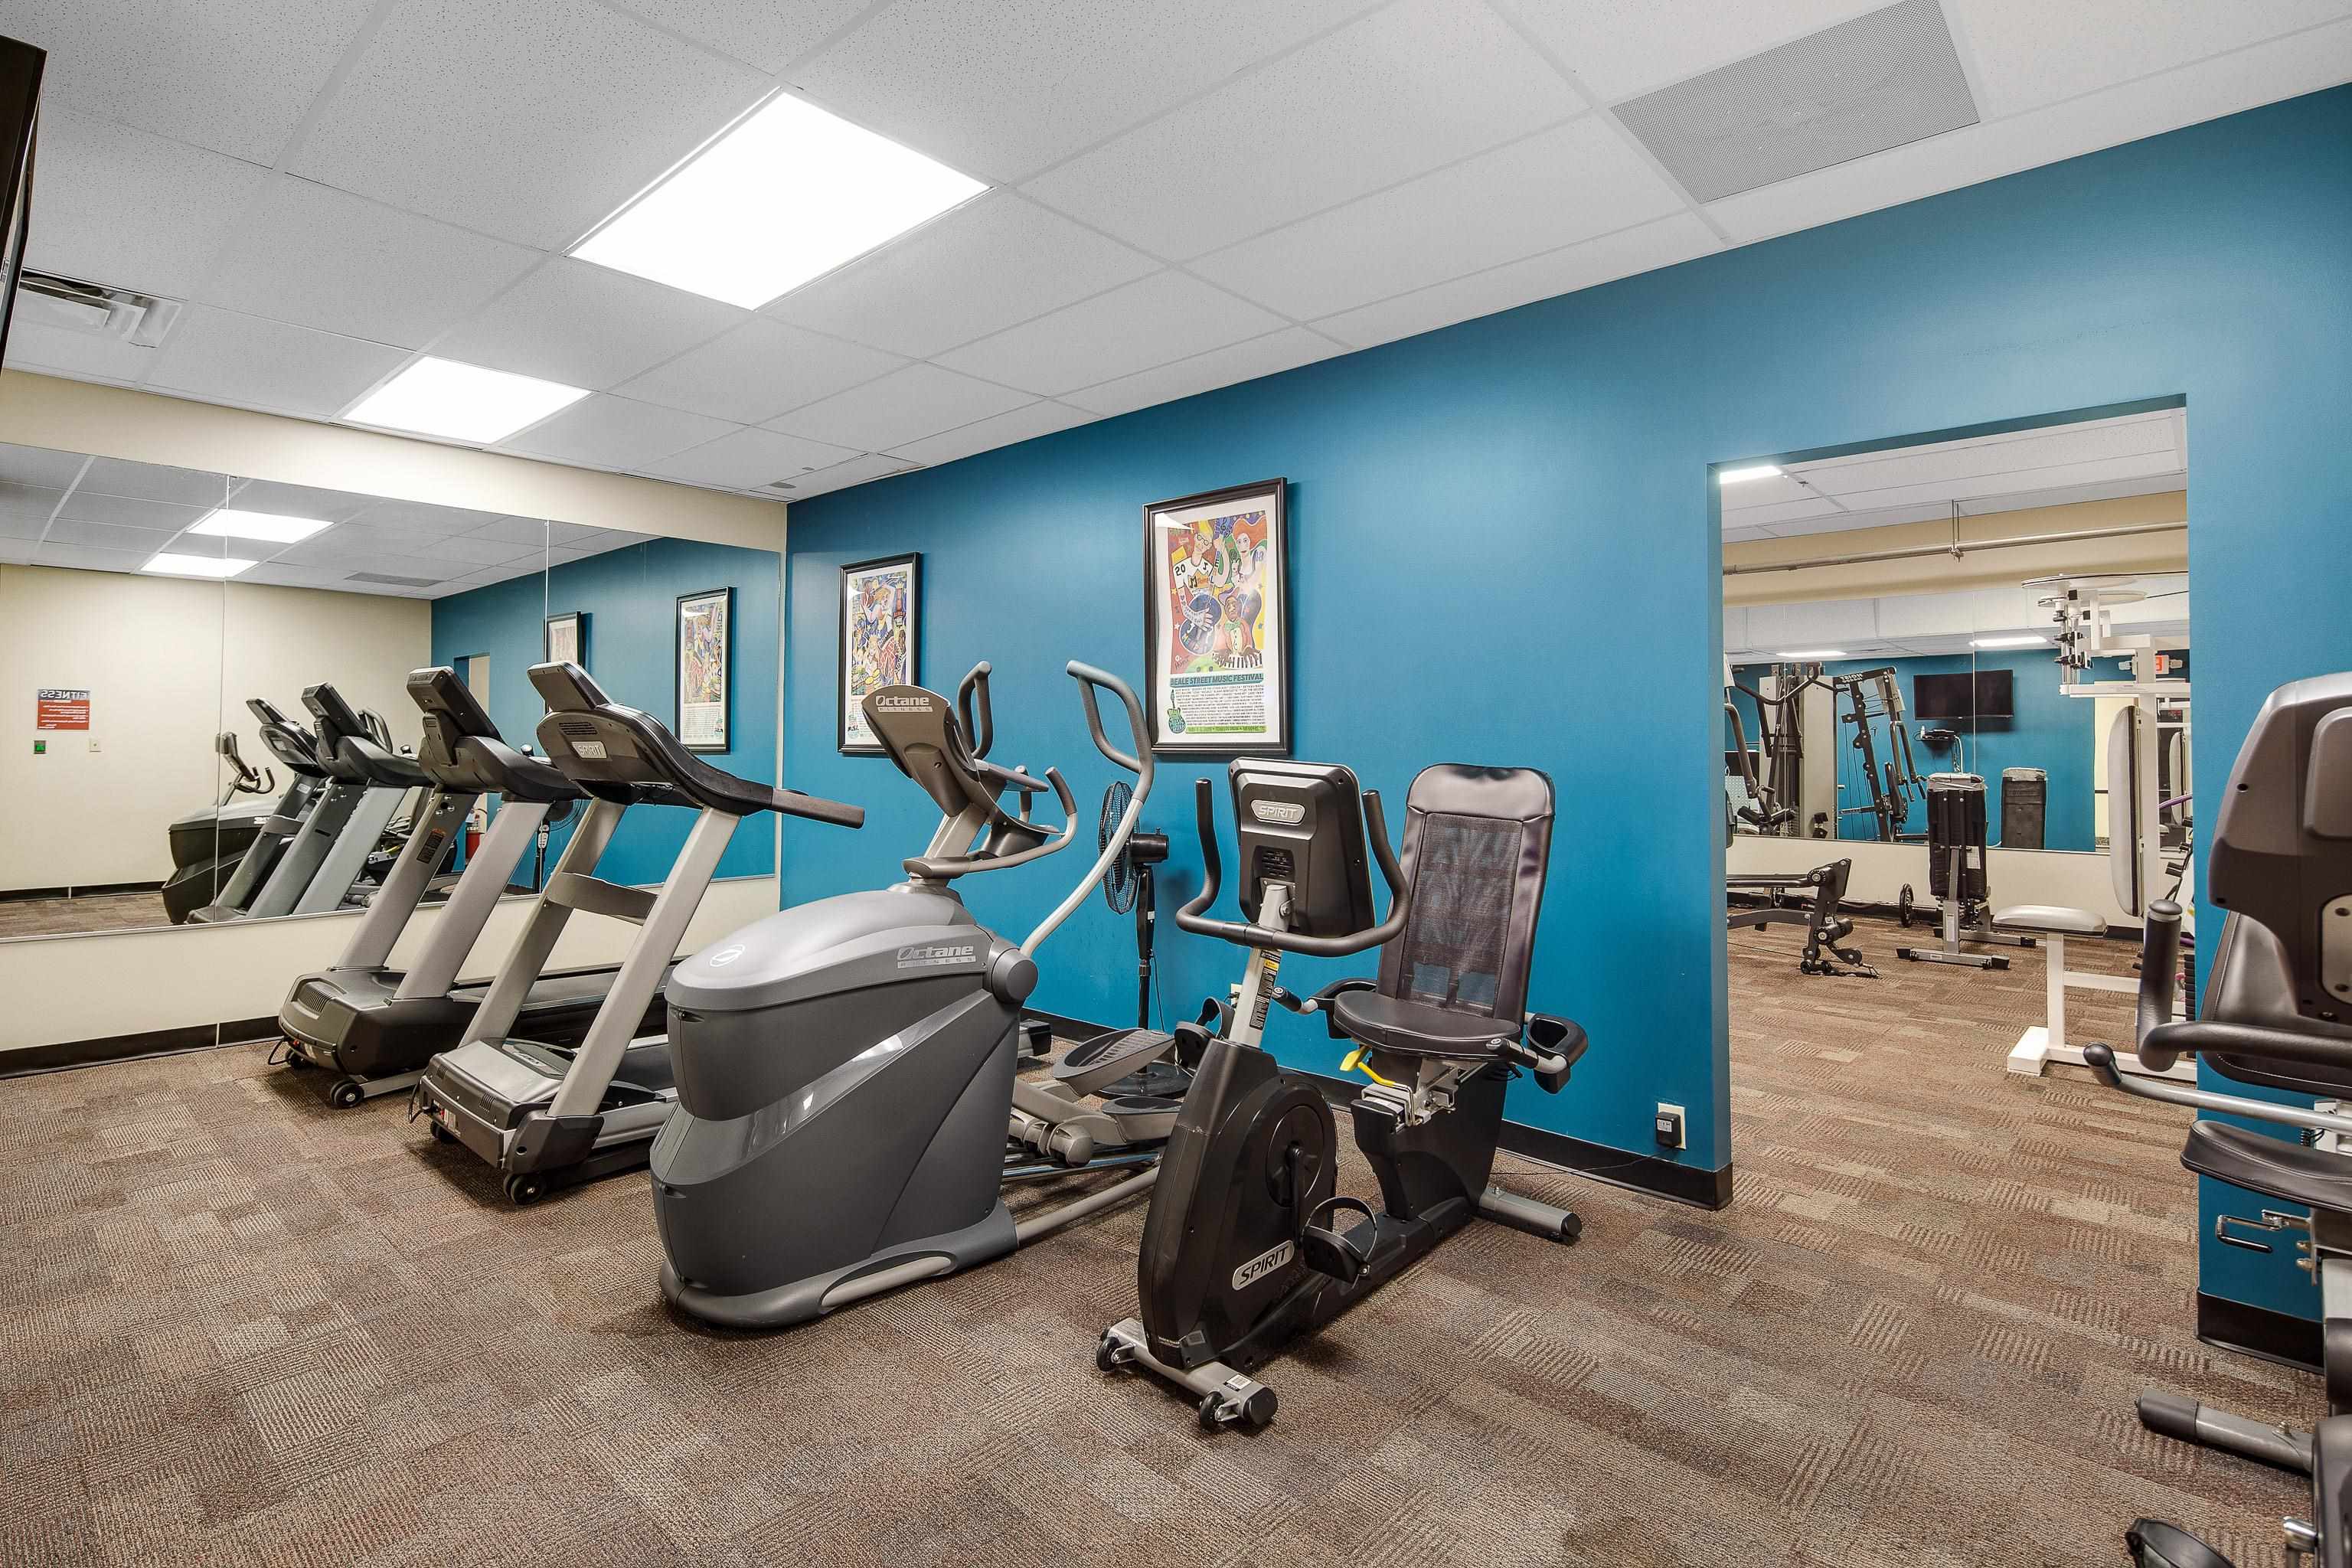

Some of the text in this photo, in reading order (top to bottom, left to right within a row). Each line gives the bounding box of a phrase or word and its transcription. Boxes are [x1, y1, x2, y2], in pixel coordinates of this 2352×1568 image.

[1174, 564, 1186, 576] 20
[1171, 673, 1264, 686] BEALE STREET MUSIC FESTIVAL
[875, 695, 929, 706] Octane
[1258, 805, 1298, 818] SPIRIT
[897, 946, 974, 960] Octane
[1239, 1245, 1289, 1285] SPIRIT
